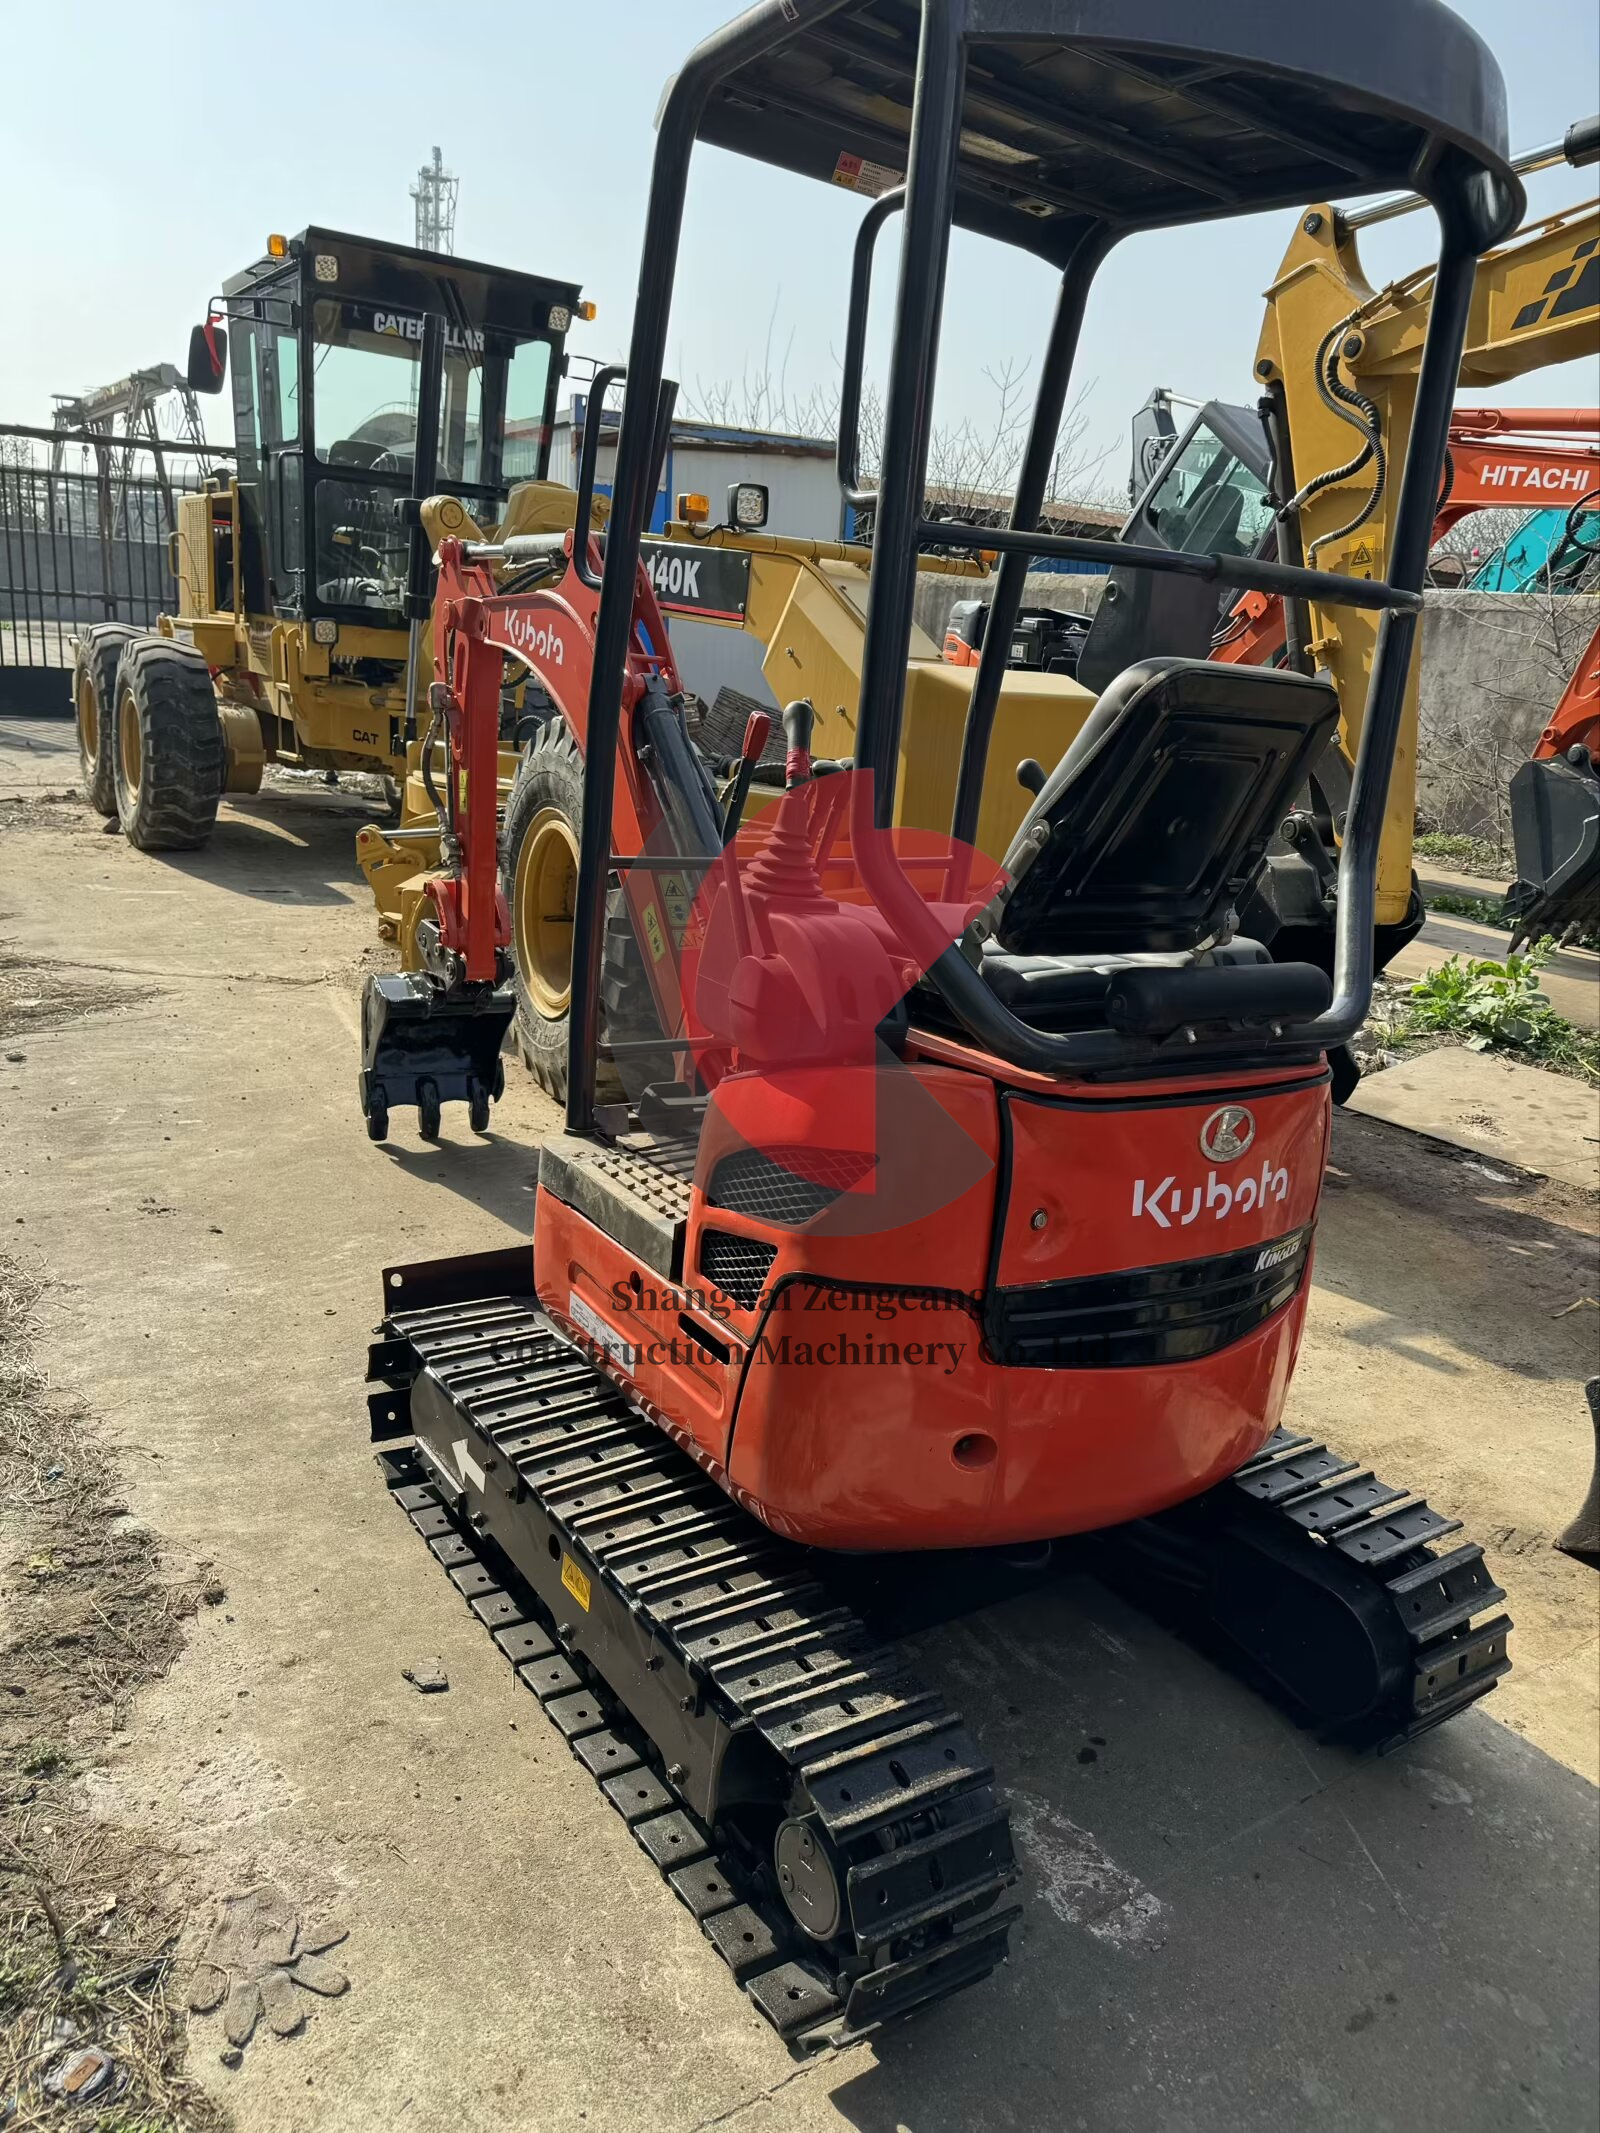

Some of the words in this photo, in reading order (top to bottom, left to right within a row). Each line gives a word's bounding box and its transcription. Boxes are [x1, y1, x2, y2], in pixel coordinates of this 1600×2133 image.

[1480, 464, 1590, 491] HITACHI
[647, 554, 702, 598] 140K
[504, 606, 564, 666] Kubota
[352, 729, 379, 745] CAT
[1131, 1159, 1289, 1228] Kubota
